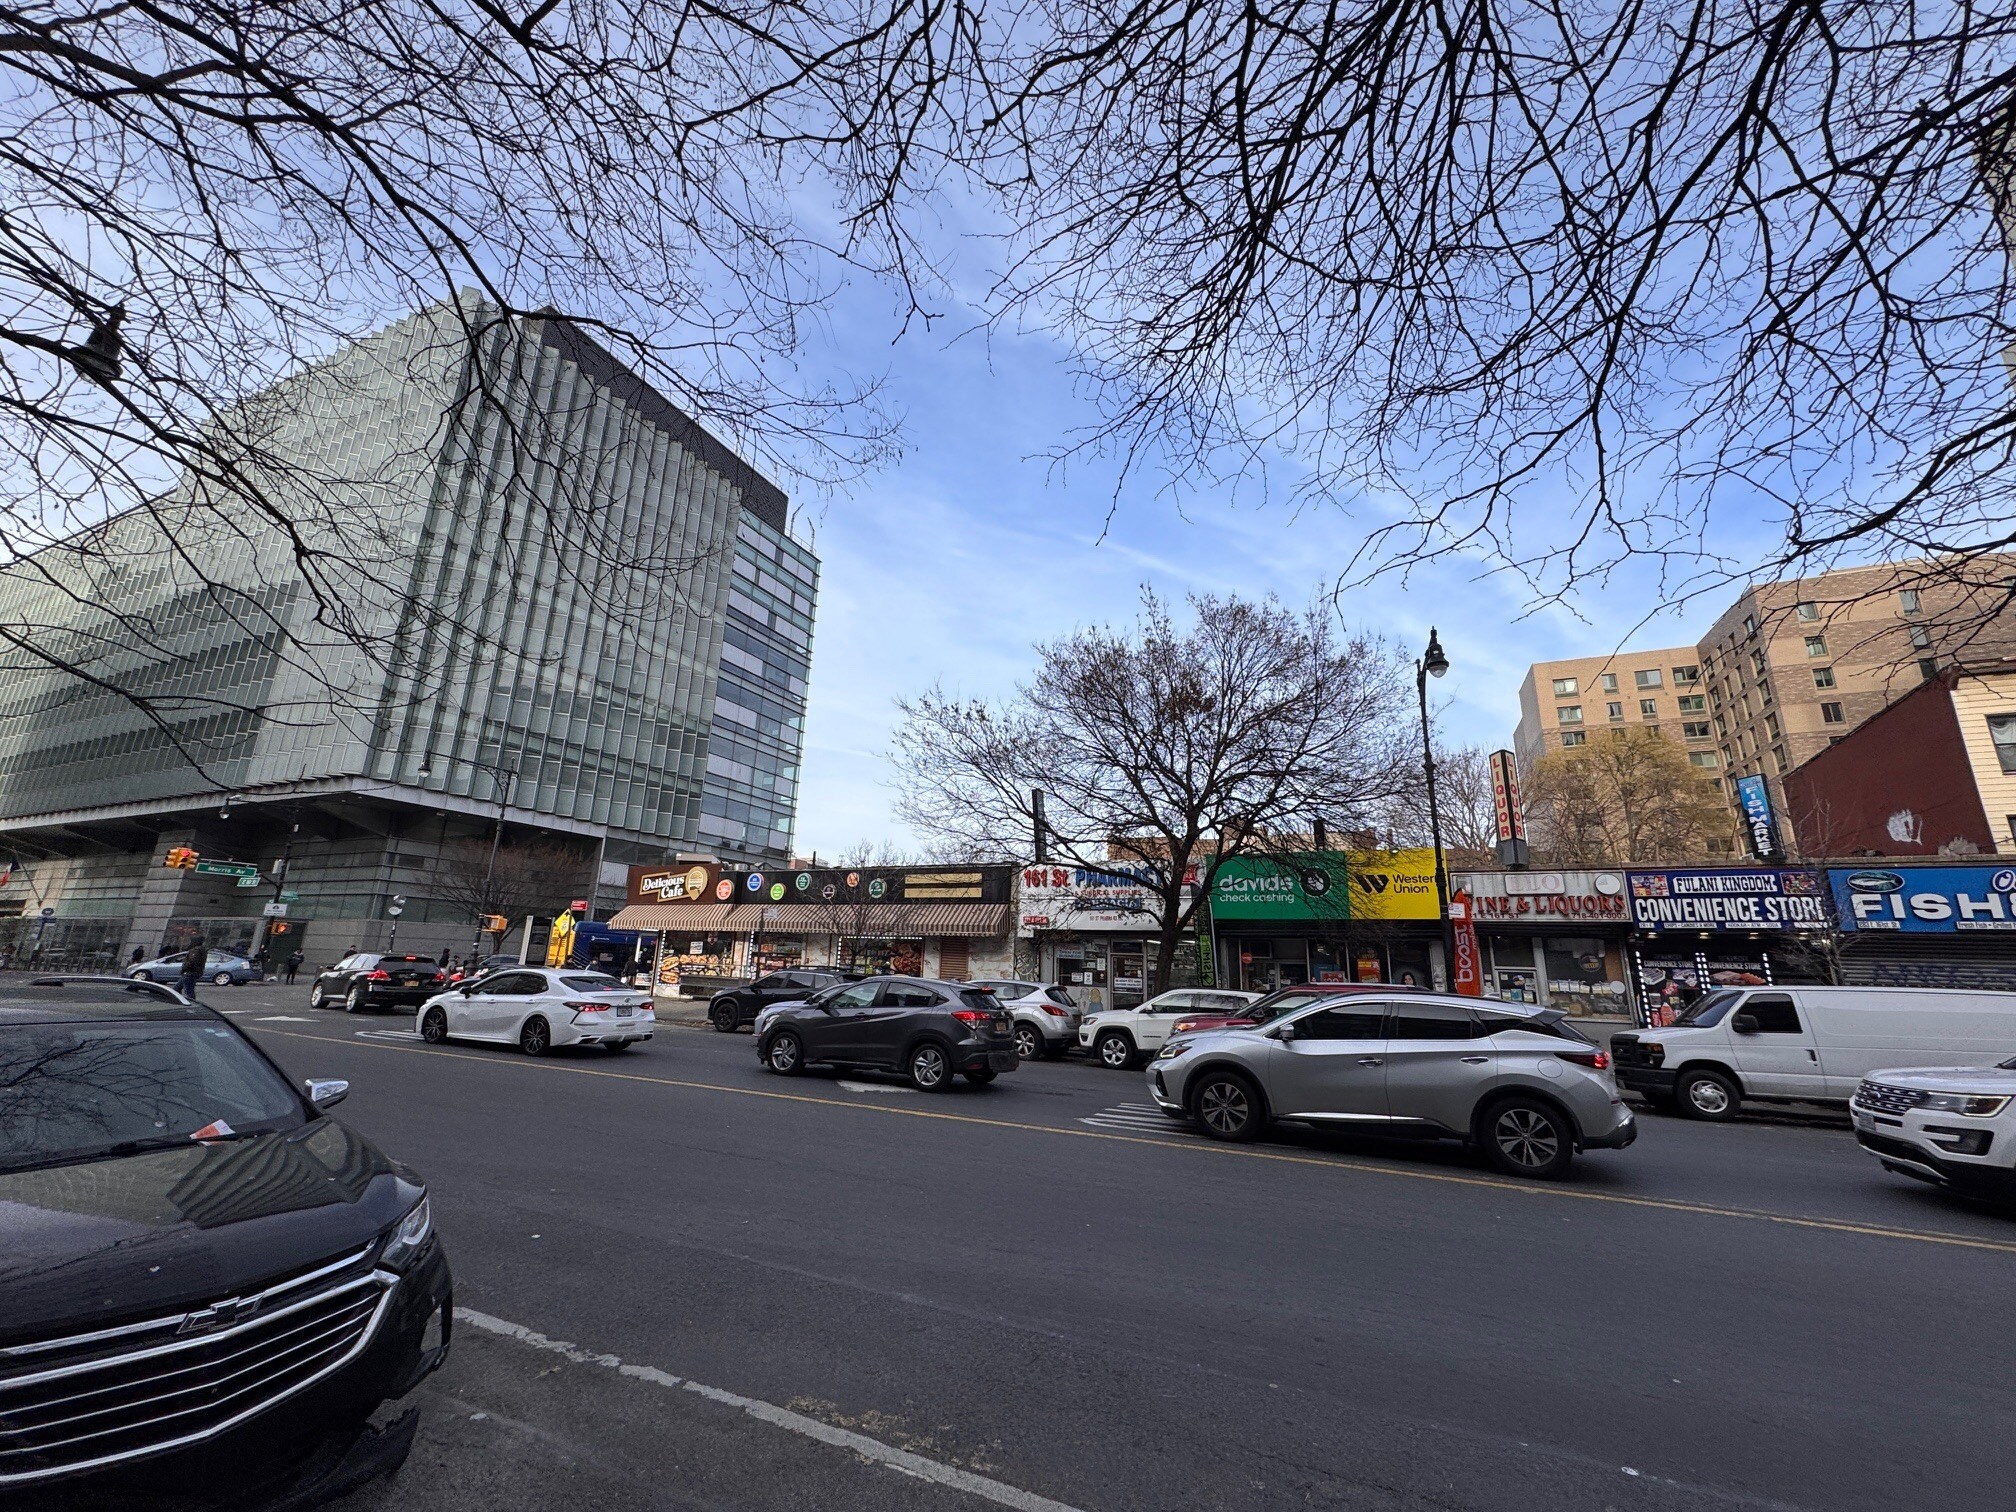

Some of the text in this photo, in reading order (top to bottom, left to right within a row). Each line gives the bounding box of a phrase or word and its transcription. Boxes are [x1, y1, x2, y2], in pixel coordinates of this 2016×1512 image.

[1493, 758, 1510, 838] LIQUOR
[1507, 756, 1523, 837] LIQUOR
[1749, 814, 1773, 856] MARKET
[208, 866, 231, 874] Morris
[1024, 869, 1047, 887] 161
[1051, 868, 1071, 887] St.
[642, 876, 685, 891] Delicious
[1393, 874, 1435, 884] Wester
[1676, 876, 1774, 892] FULANI KINGDOM
[660, 885, 684, 899] Cafe
[1394, 885, 1429, 894] Union
[1219, 893, 1295, 904] check cashing
[1516, 896, 1531, 913] &
[1534, 895, 1626, 915] LIQUORS
[1635, 898, 1762, 922] CONVENIENCE
[1454, 924, 1474, 983] boost
[1679, 961, 1695, 969] STORE
[1709, 962, 1762, 970] CONVENIENCE STORE
